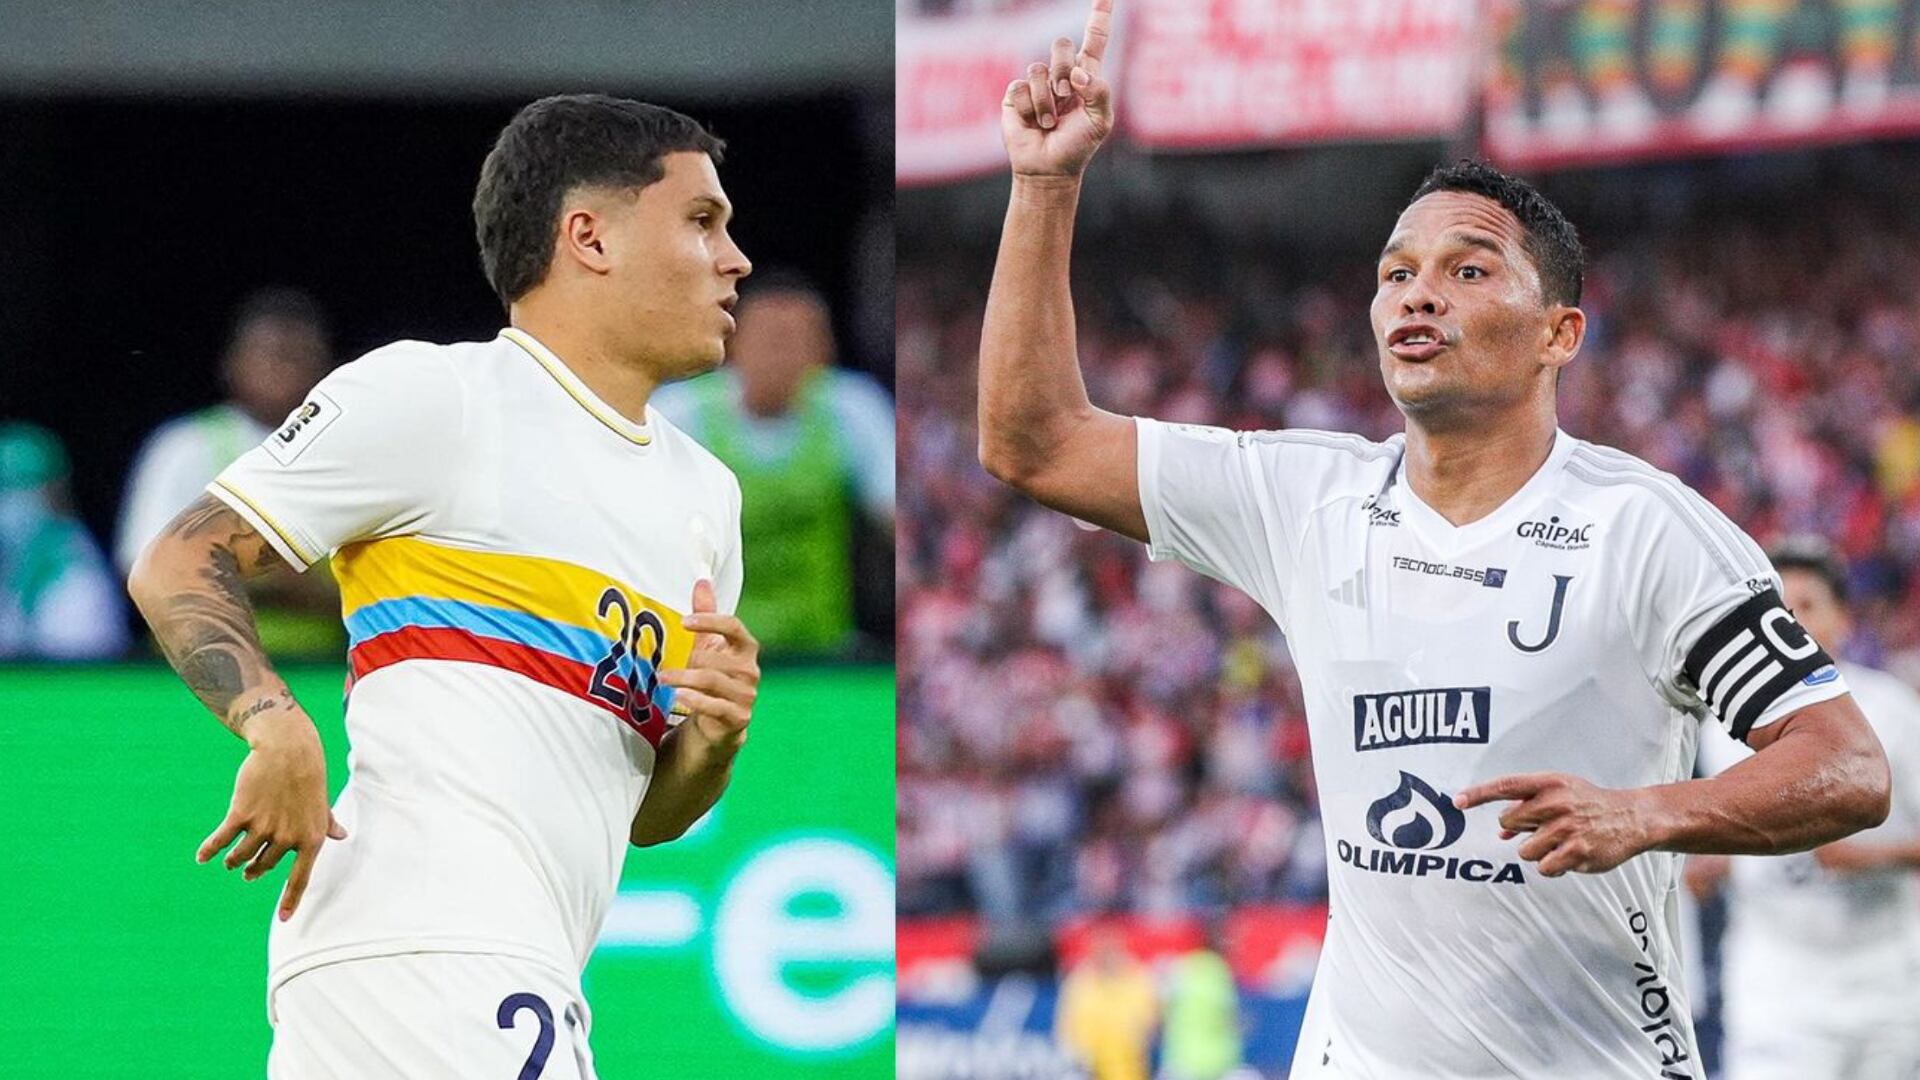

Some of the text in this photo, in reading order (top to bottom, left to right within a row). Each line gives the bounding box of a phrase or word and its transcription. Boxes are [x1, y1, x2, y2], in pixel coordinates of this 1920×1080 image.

[1393, 556, 1484, 582] TECNOGLASS
[1507, 575, 1575, 653] J
[1760, 606, 1819, 661] C
[589, 588, 665, 723] 20
[1360, 691, 1480, 747] AGUILA
[1337, 839, 1526, 884] OLIMPICA
